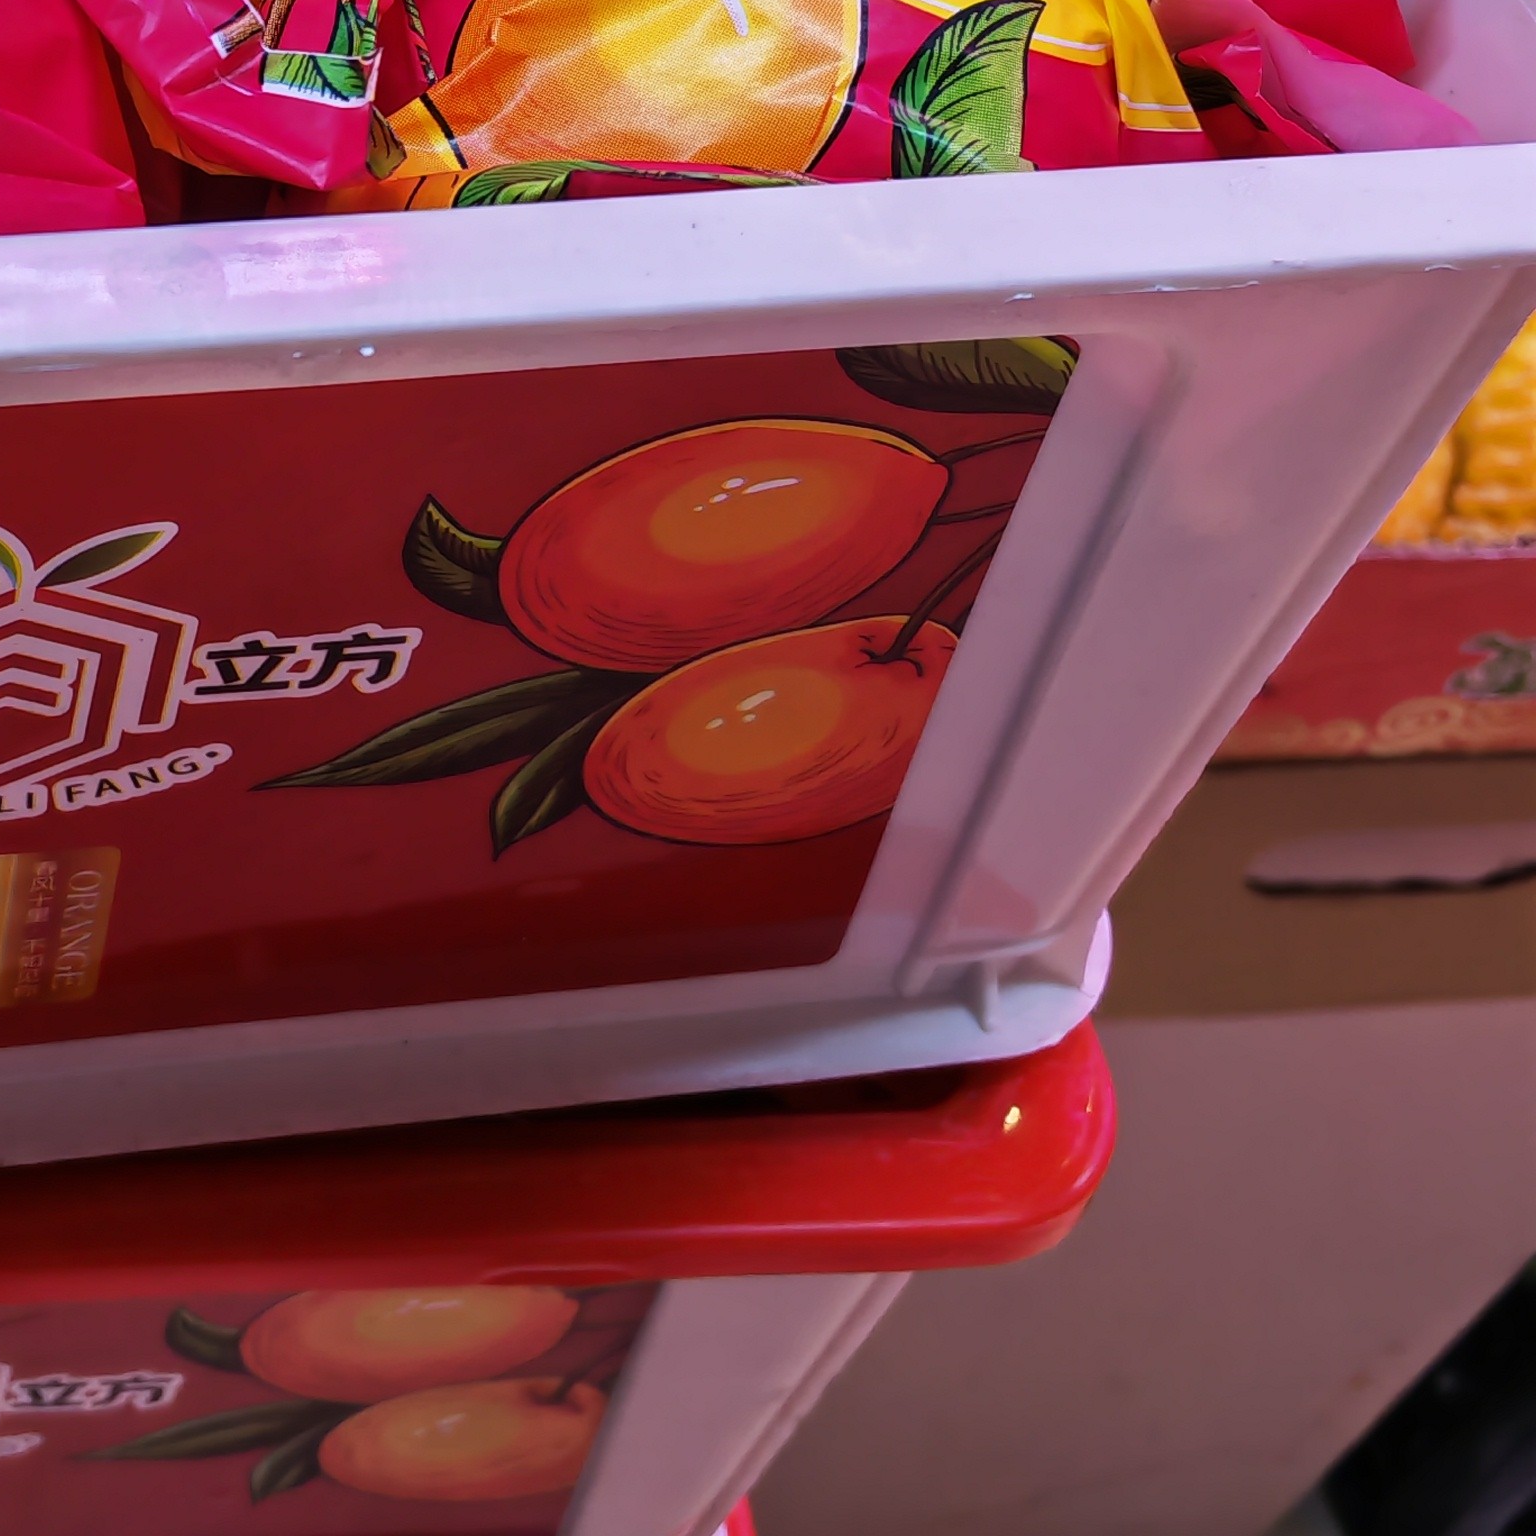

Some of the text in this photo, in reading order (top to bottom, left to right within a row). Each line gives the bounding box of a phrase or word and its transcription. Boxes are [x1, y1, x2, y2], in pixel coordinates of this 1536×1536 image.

[195, 631, 407, 695] 立方
[66, 755, 201, 804] FANG
[52, 869, 102, 990] ORANGE
[11, 1375, 174, 1407] 立方
